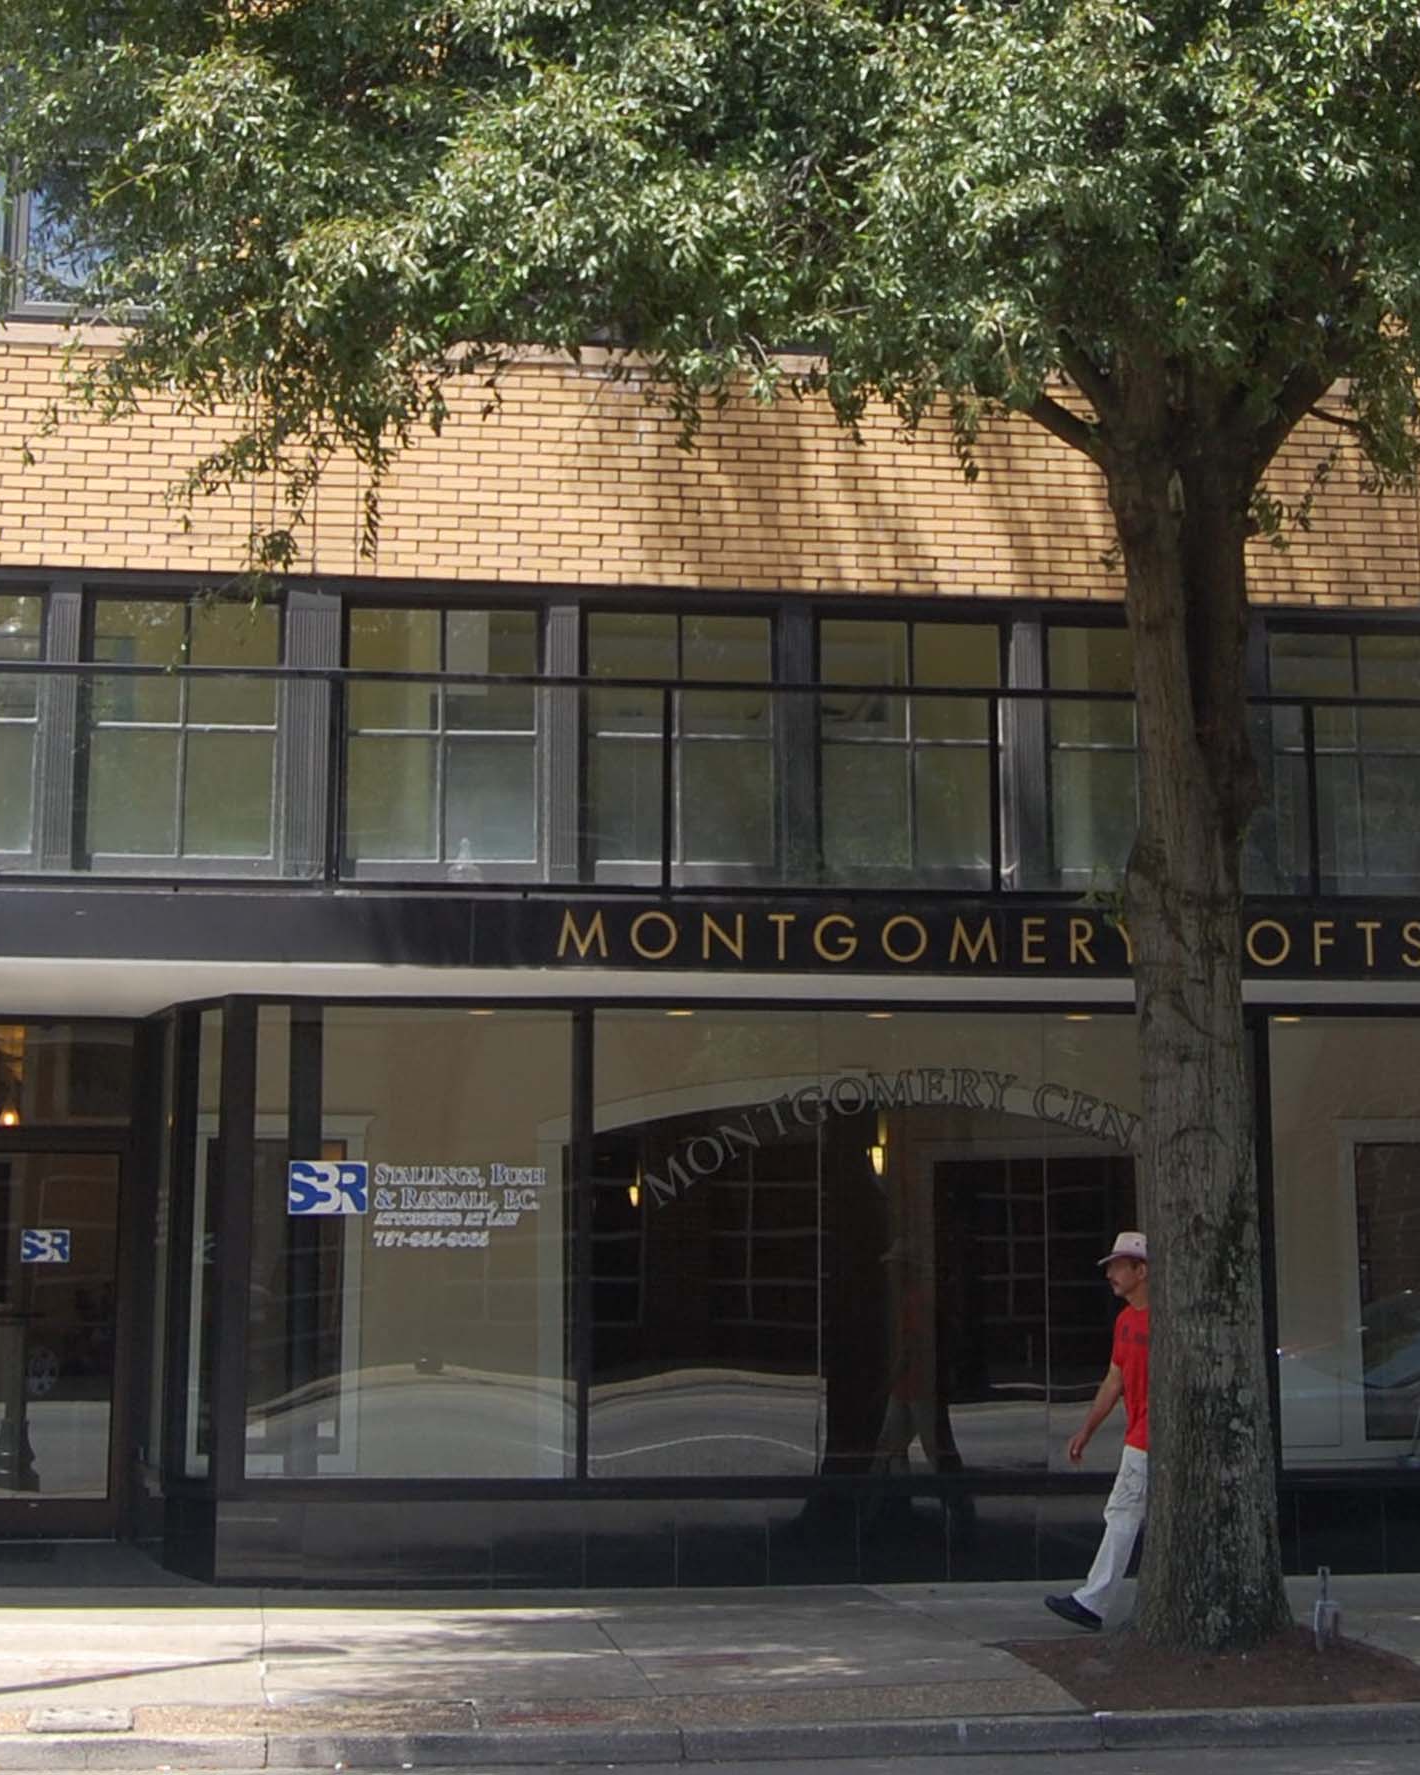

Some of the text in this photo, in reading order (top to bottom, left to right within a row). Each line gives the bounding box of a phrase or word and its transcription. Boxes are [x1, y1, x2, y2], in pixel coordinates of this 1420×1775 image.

[556, 909, 1136, 966] MONTGOMERY
[643, 1067, 1141, 1209] MONTGOMERY CEN
[373, 1188, 397, 1210] &
